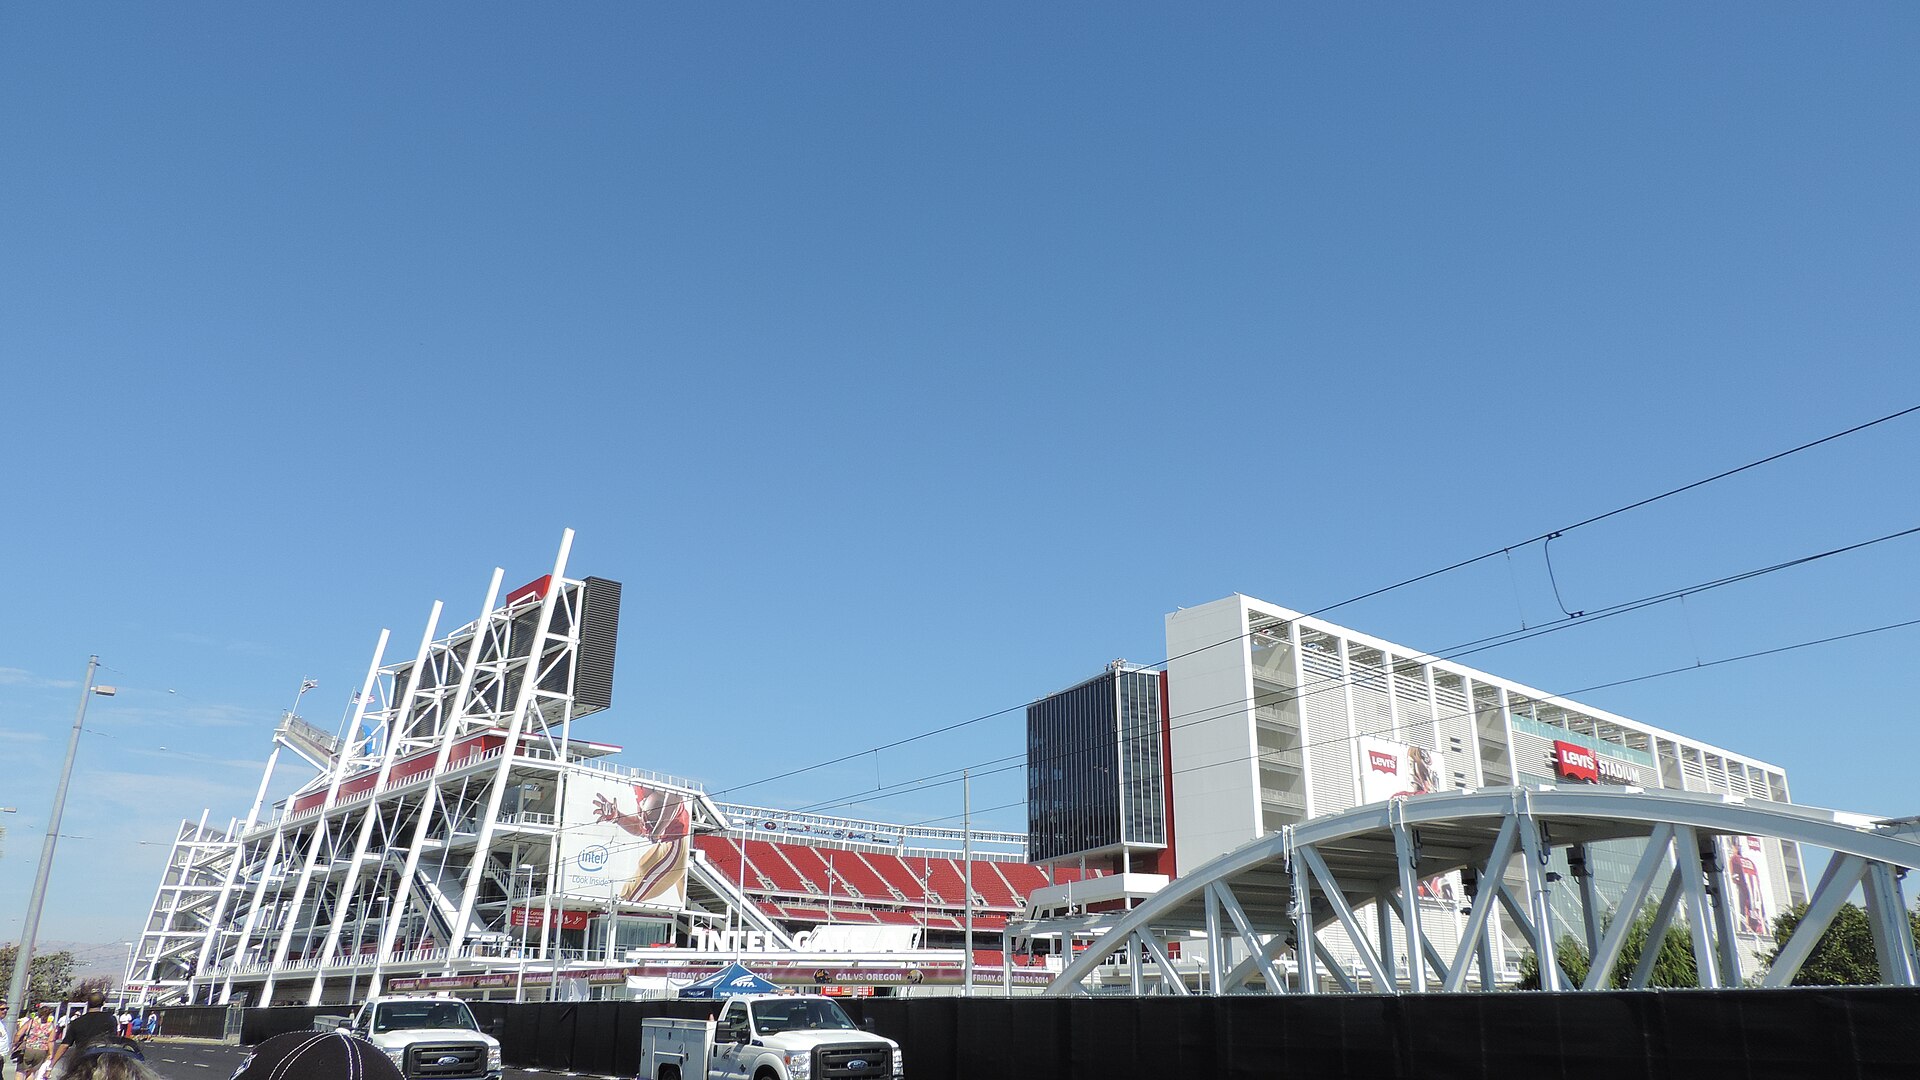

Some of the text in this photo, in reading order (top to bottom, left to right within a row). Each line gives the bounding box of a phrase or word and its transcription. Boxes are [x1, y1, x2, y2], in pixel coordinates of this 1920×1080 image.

[1598, 759, 1640, 782] STADIUM
[581, 850, 604, 864] intel
[572, 875, 588, 885] Look
[698, 930, 780, 952] INTEL
[667, 972, 699, 981] FRIDAY,
[836, 973, 902, 981] CAL VS. OREGON
[973, 974, 997, 983] FRIDAY,
[1026, 976, 1035, 984] 24,
[1035, 976, 1049, 984] 2014
